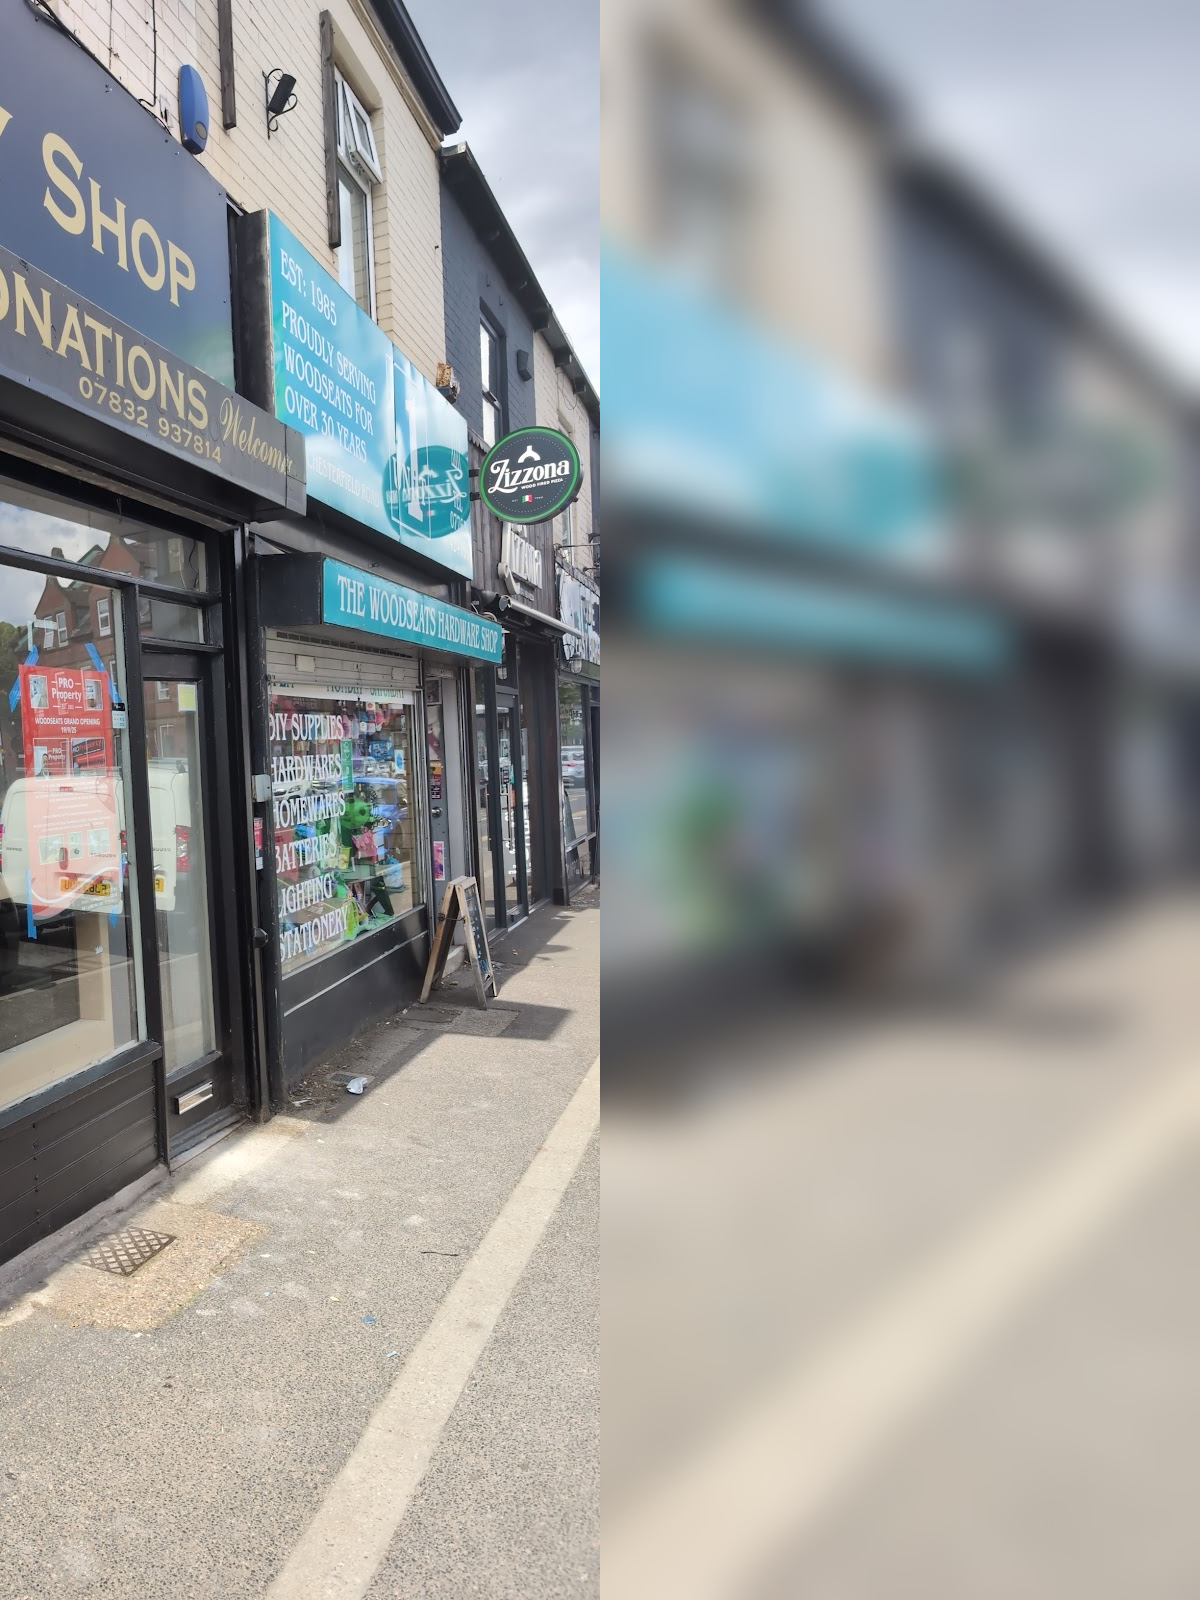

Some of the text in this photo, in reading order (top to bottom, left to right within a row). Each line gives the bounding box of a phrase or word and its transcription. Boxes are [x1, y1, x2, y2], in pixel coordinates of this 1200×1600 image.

[42, 132, 196, 307] SHOP
[280, 248, 337, 326] EST: 1985
[281, 300, 376, 405] PROUDLY SERVING
[283, 342, 374, 436] WOODSEATS FOR
[79, 376, 221, 464] 07832 937814
[285, 385, 367, 463] OVER 30 YEARS
[487, 459, 570, 494] Zizzona
[551, 477, 564, 485] PIZZA
[337, 574, 498, 653] THE WOODSEATS HARDWARE SHOP
[35, 717, 63, 725] WOODSEATS
[80, 718, 101, 726] OPENING
[51, 688, 82, 702] Property
[58, 677, 74, 689] PRO
[291, 713, 344, 741] SUPPLIES
